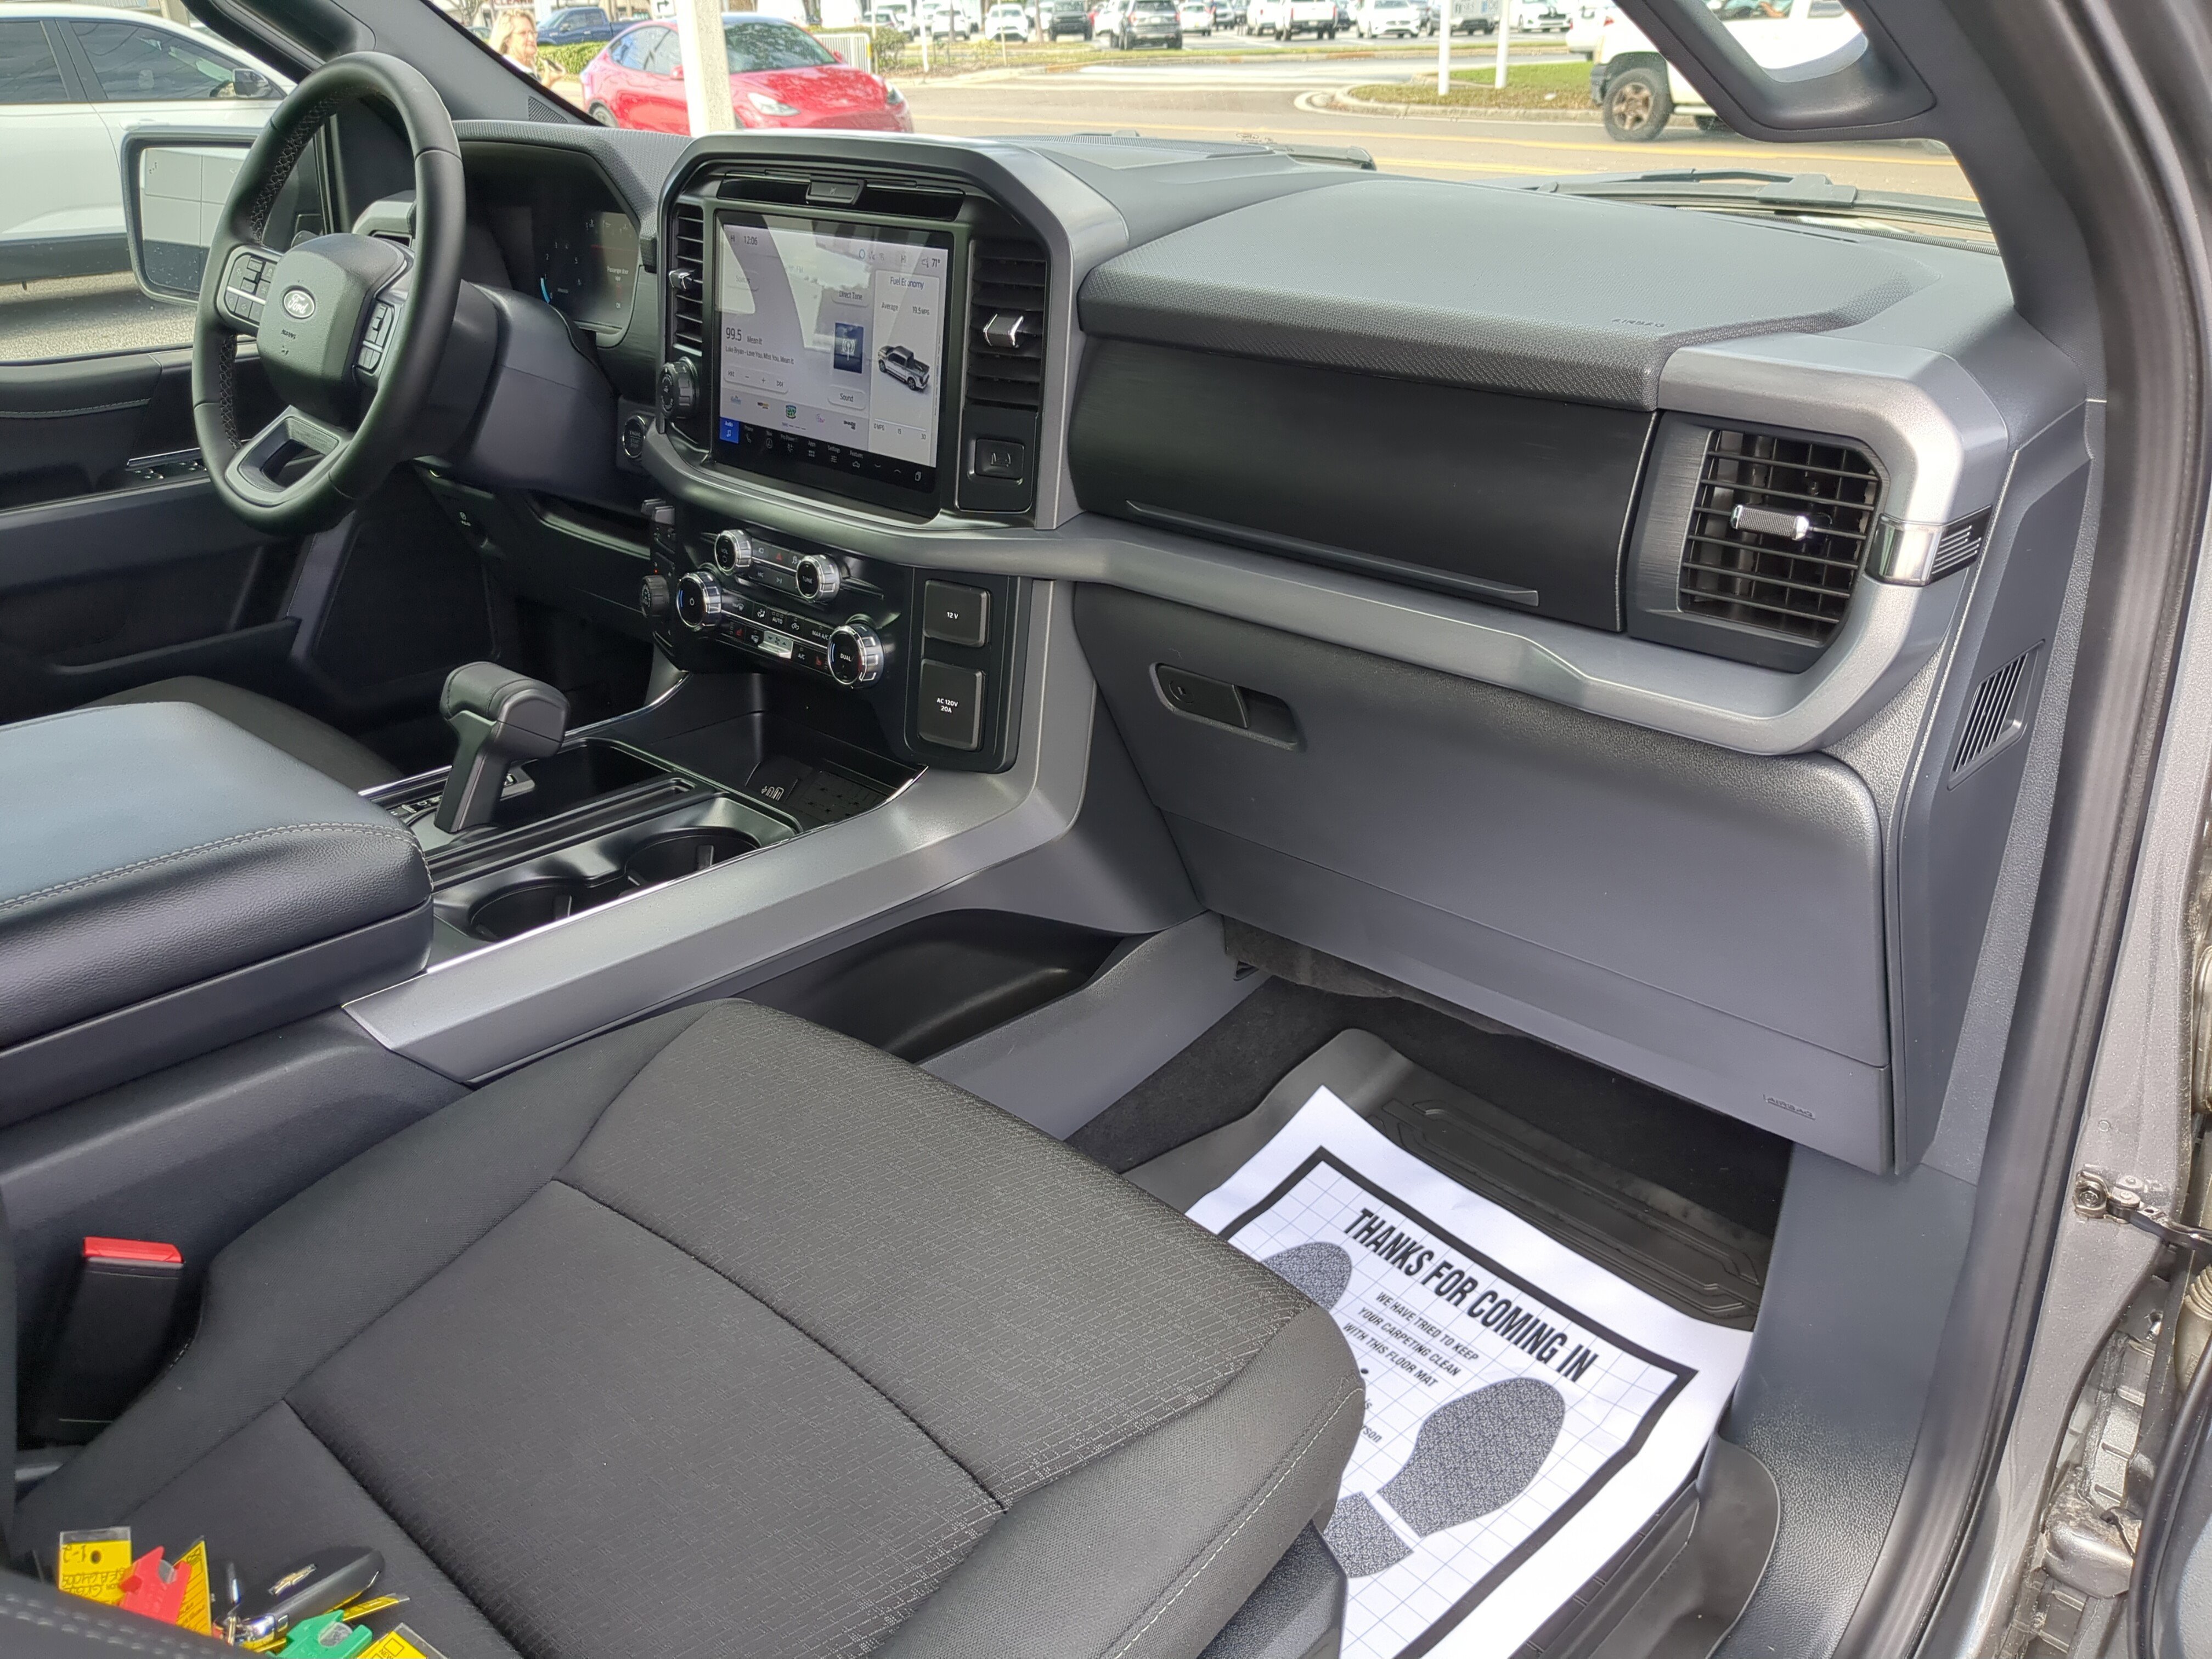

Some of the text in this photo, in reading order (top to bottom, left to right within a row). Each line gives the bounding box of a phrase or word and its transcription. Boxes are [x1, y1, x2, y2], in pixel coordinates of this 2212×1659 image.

[744, 235, 758, 245] 12:06
[890, 276, 924, 290] Fuel Economy
[839, 290, 862, 301] Direct Tune
[288, 294, 309, 314] Ford
[881, 302, 899, 312] Average
[1611, 318, 1665, 328] AIRBAG
[725, 327, 742, 341] 99.5
[840, 393, 854, 402] Sound
[802, 575, 813, 584] TUNE
[772, 617, 783, 625] AUTO
[812, 629, 821, 637] MAX
[840, 653, 851, 662] DUAL
[945, 699, 958, 707] 120V
[940, 705, 952, 713] 20A
[1344, 1207, 1599, 1383] THANKS FOR COMING IN
[1376, 1291, 1479, 1361] WE HAVE TRIED TO KEEP
[1358, 1307, 1462, 1376] YOUR CARPETING CLEAN
[1343, 1322, 1438, 1387] WITH THIS FLOOR MAT
